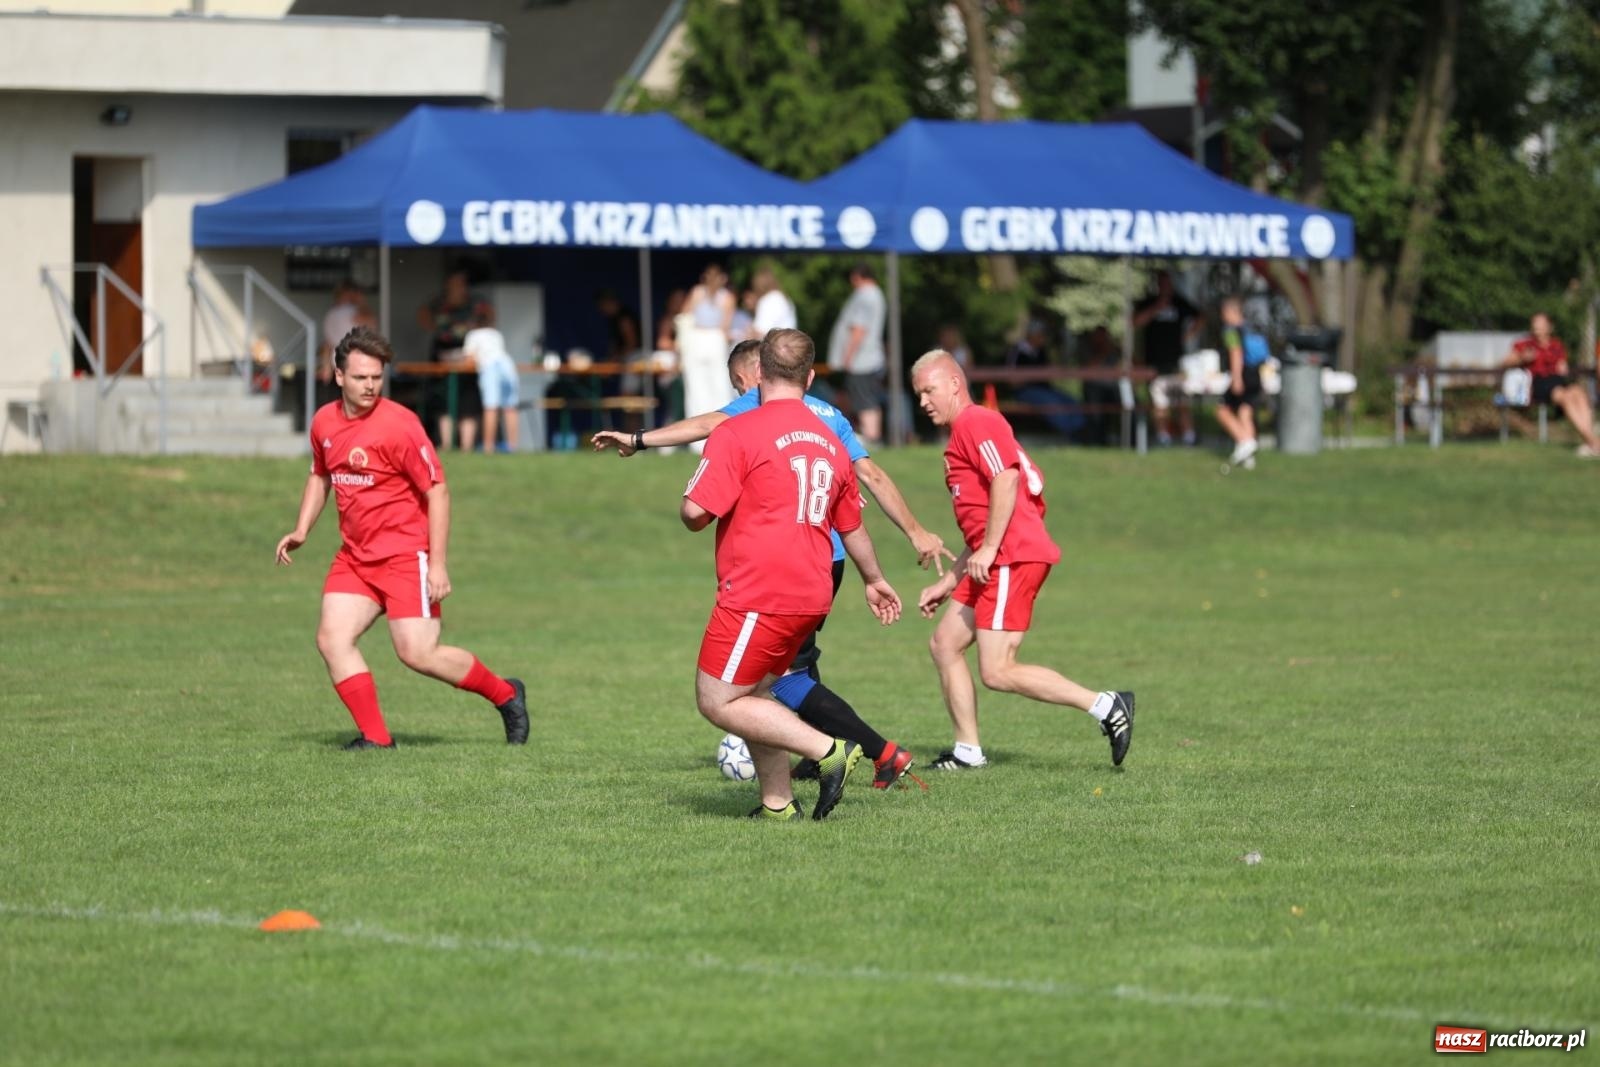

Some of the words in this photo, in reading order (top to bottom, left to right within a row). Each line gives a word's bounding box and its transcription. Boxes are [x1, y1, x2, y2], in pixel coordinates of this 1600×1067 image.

[463, 201, 567, 244] GCBK
[573, 202, 824, 248] KRZANOWICE
[961, 207, 1057, 251] GCBK
[1062, 209, 1290, 256] KRZANOWICE
[790, 455, 834, 526] 18
